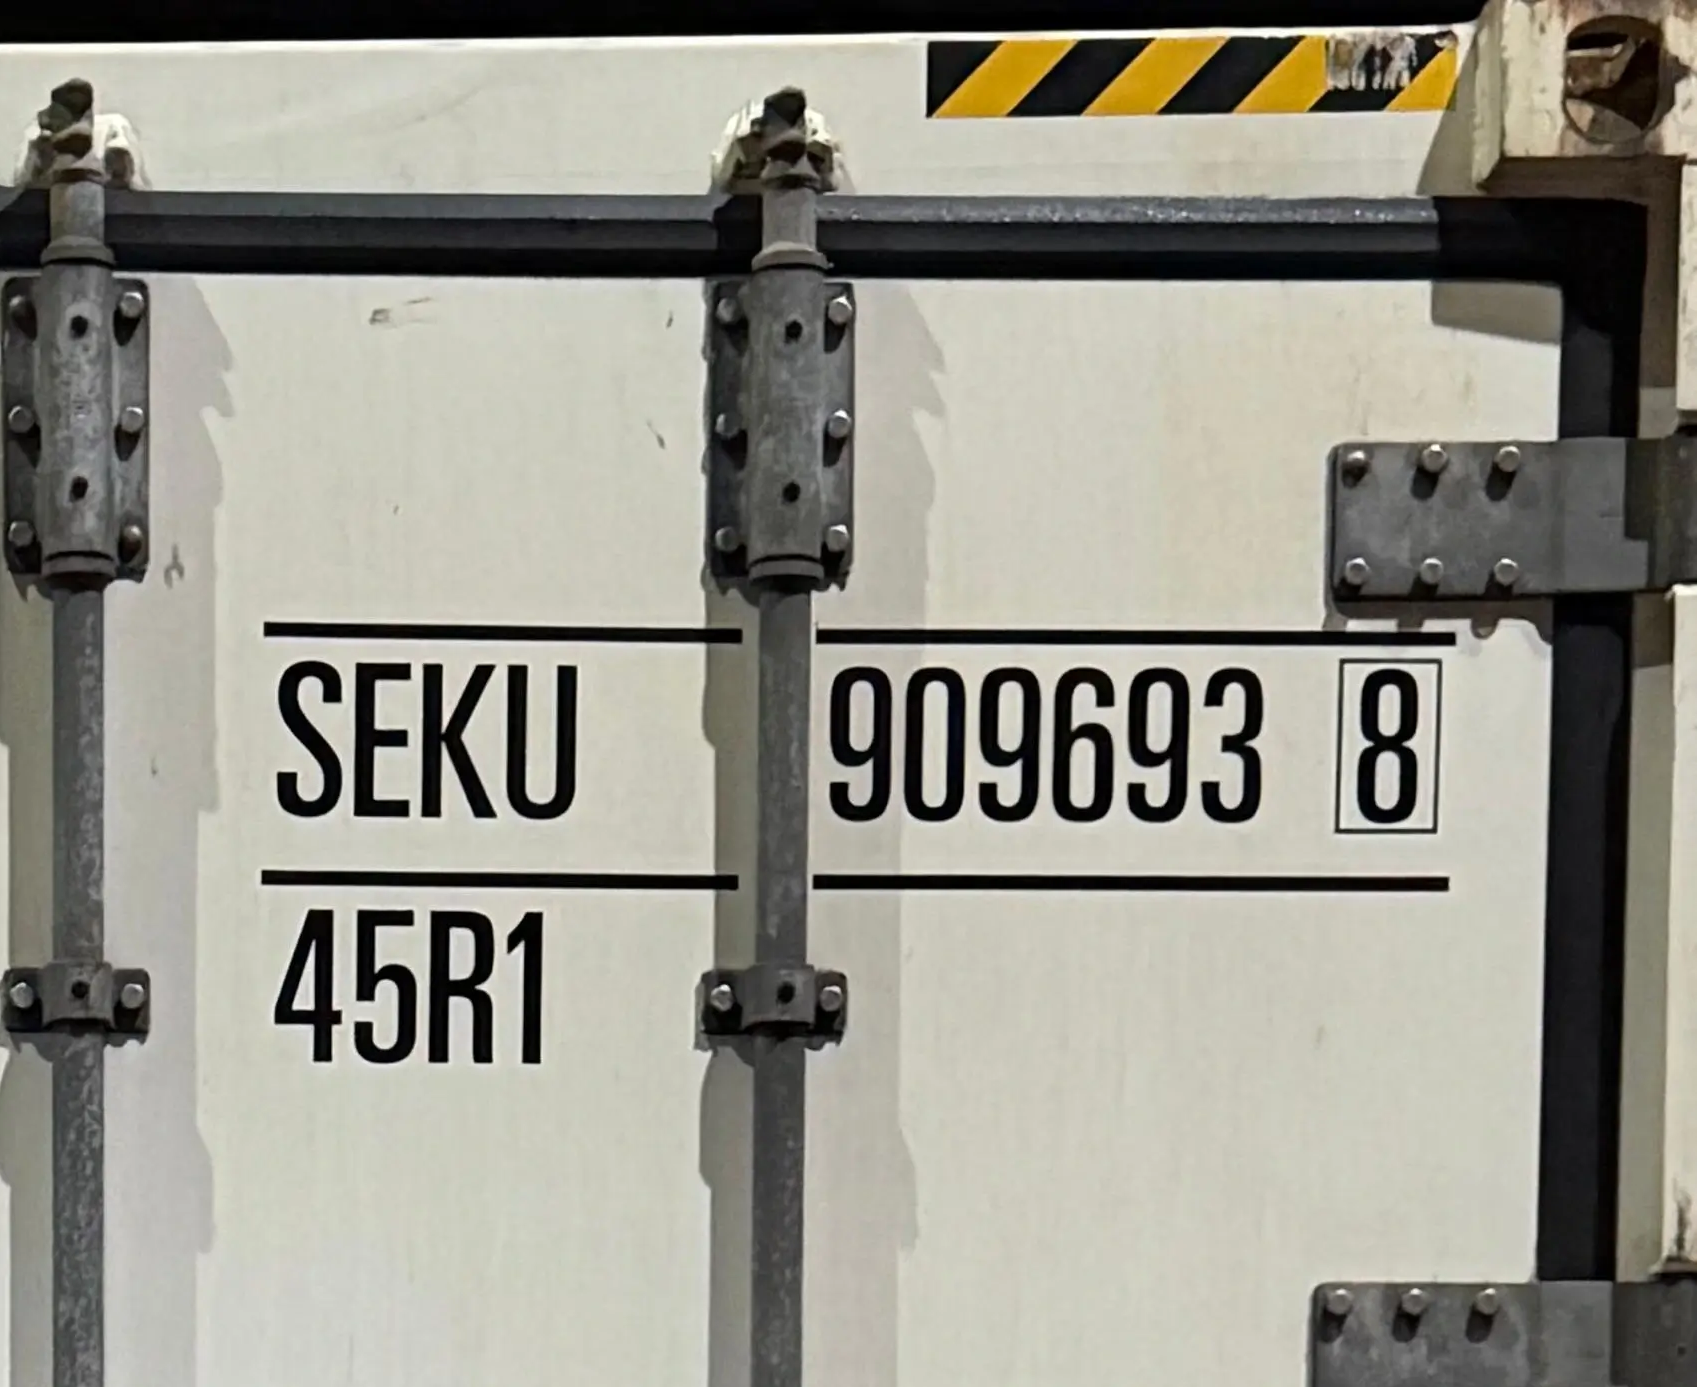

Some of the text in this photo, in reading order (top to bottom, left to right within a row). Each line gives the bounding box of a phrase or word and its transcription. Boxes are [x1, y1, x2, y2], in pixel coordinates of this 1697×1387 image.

[277, 661, 1420, 824] SEKU 909693 8
[275, 910, 543, 1064] 45R1
